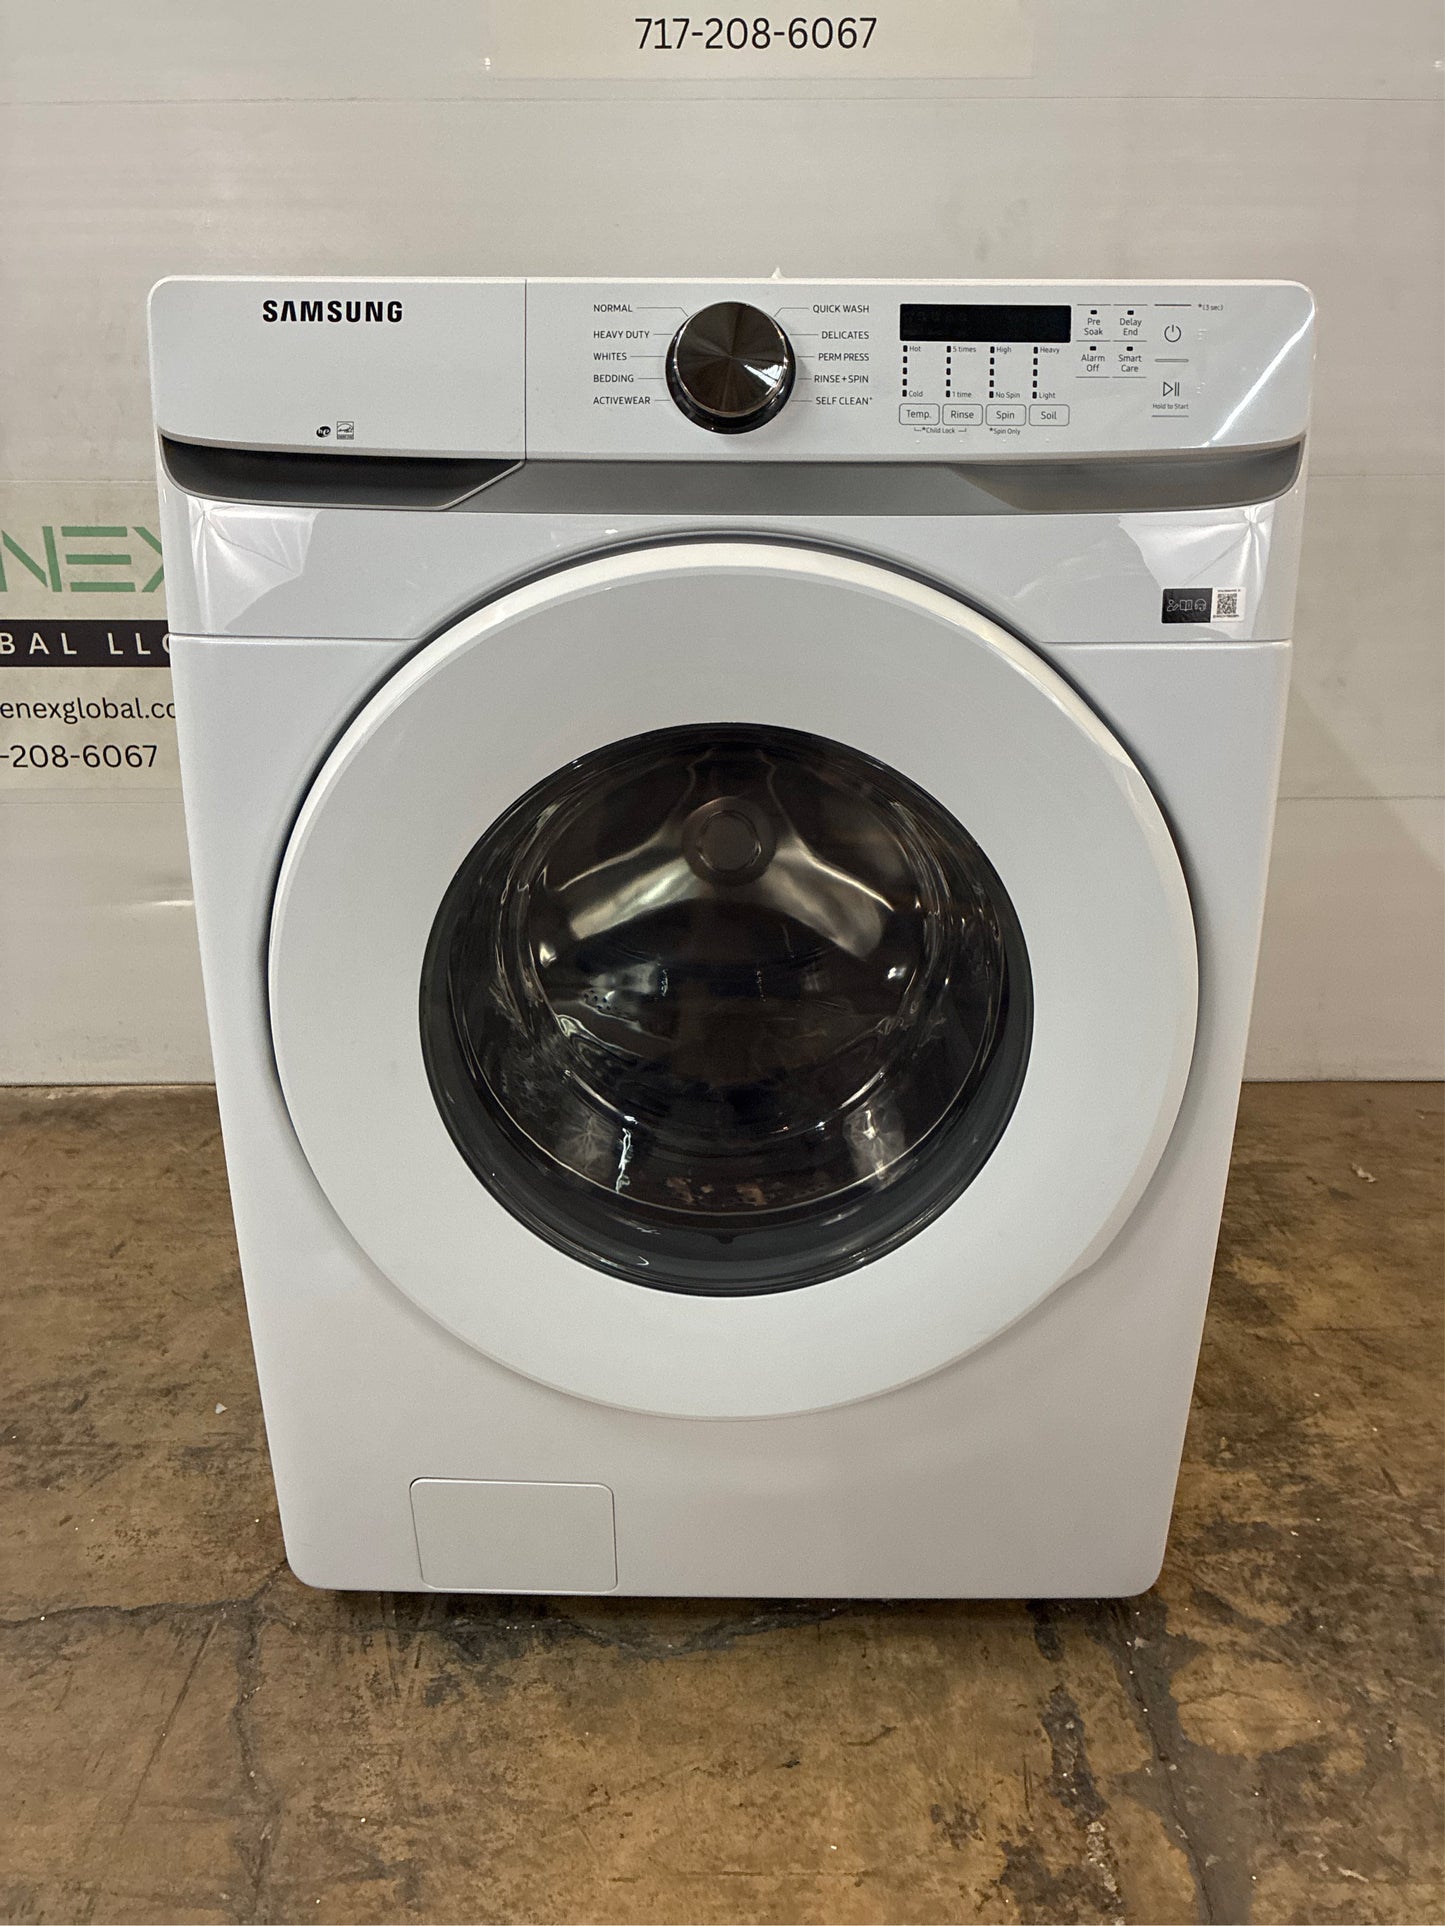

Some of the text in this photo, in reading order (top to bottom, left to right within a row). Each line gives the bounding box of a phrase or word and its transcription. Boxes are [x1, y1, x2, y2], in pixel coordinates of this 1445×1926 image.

[634, 17, 878, 49] 717-208-6067
[262, 300, 403, 322] SAMSUNG
[593, 304, 633, 313] NORMAL
[812, 305, 870, 314] QUICK WASH
[1087, 318, 1100, 326] Pre
[1119, 318, 1142, 326] Delay
[593, 330, 650, 339] HEAVY DUTY
[822, 331, 869, 339] DELICATES
[1123, 328, 1138, 336] End
[593, 353, 627, 361] WHITES
[818, 353, 869, 361] PERM PRESS
[1081, 354, 1105, 362] Alarm
[1118, 354, 1142, 362] Smart
[1086, 364, 1100, 372] Off
[1039, 392, 1055, 400] Light
[593, 397, 651, 405] ACTIVEWEAR
[816, 397, 837, 405] SELF
[906, 410, 932, 420] Temp.
[950, 410, 974, 419] Rinse
[996, 411, 1015, 420] Spin
[1040, 411, 1057, 419] Soil
[0, 632, 77, 655] BAL
